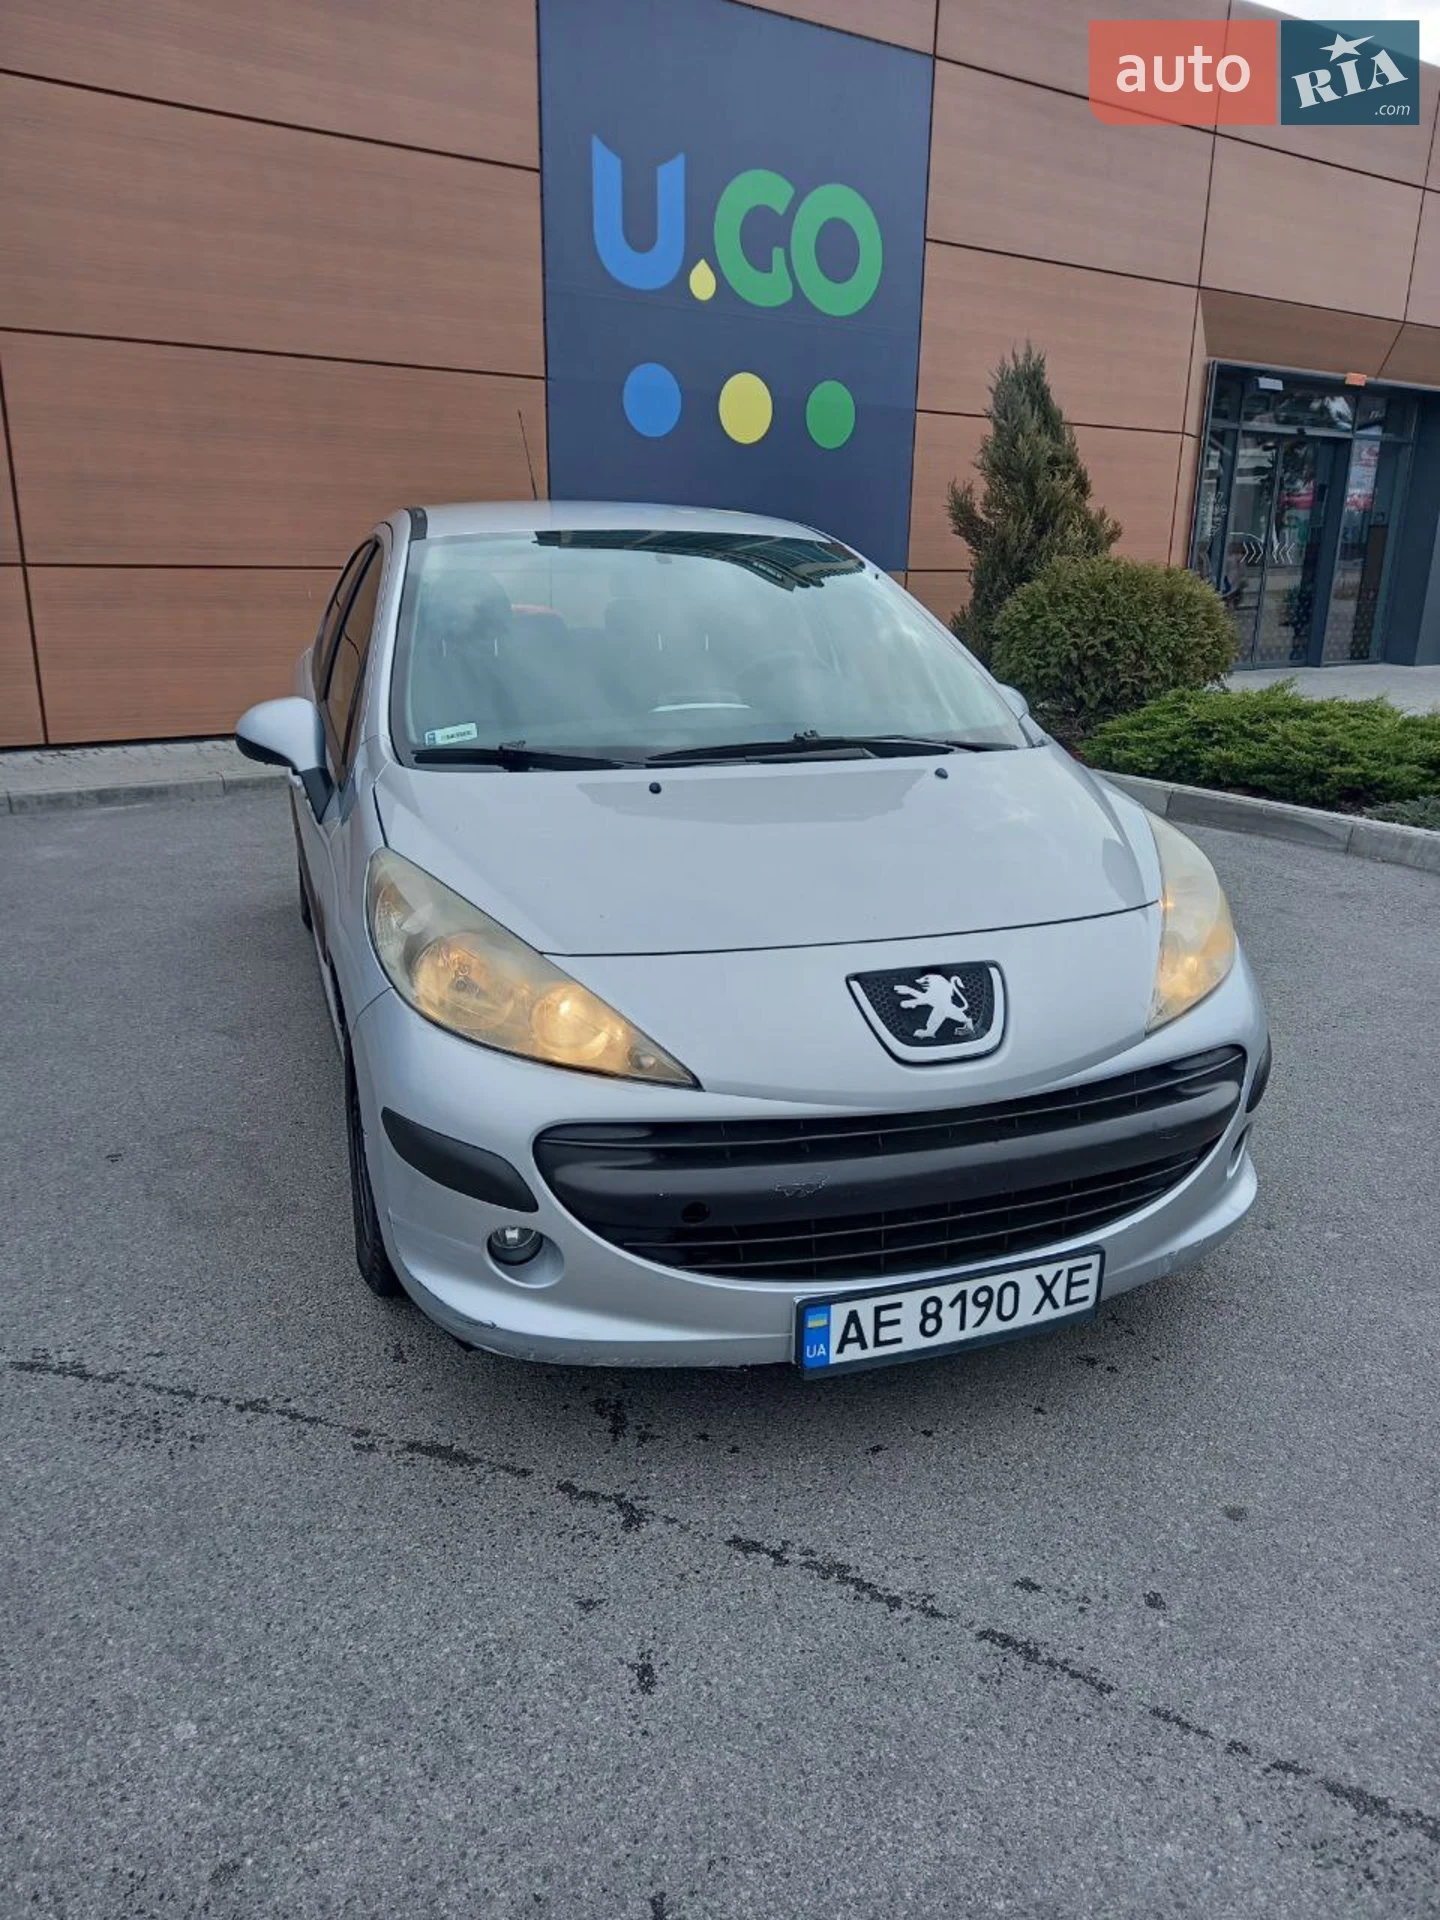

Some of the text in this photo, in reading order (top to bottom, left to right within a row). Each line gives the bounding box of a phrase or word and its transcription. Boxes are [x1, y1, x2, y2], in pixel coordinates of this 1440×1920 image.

[836, 1262, 1093, 1354] AE 8190 XE
[805, 1343, 827, 1358] UA
